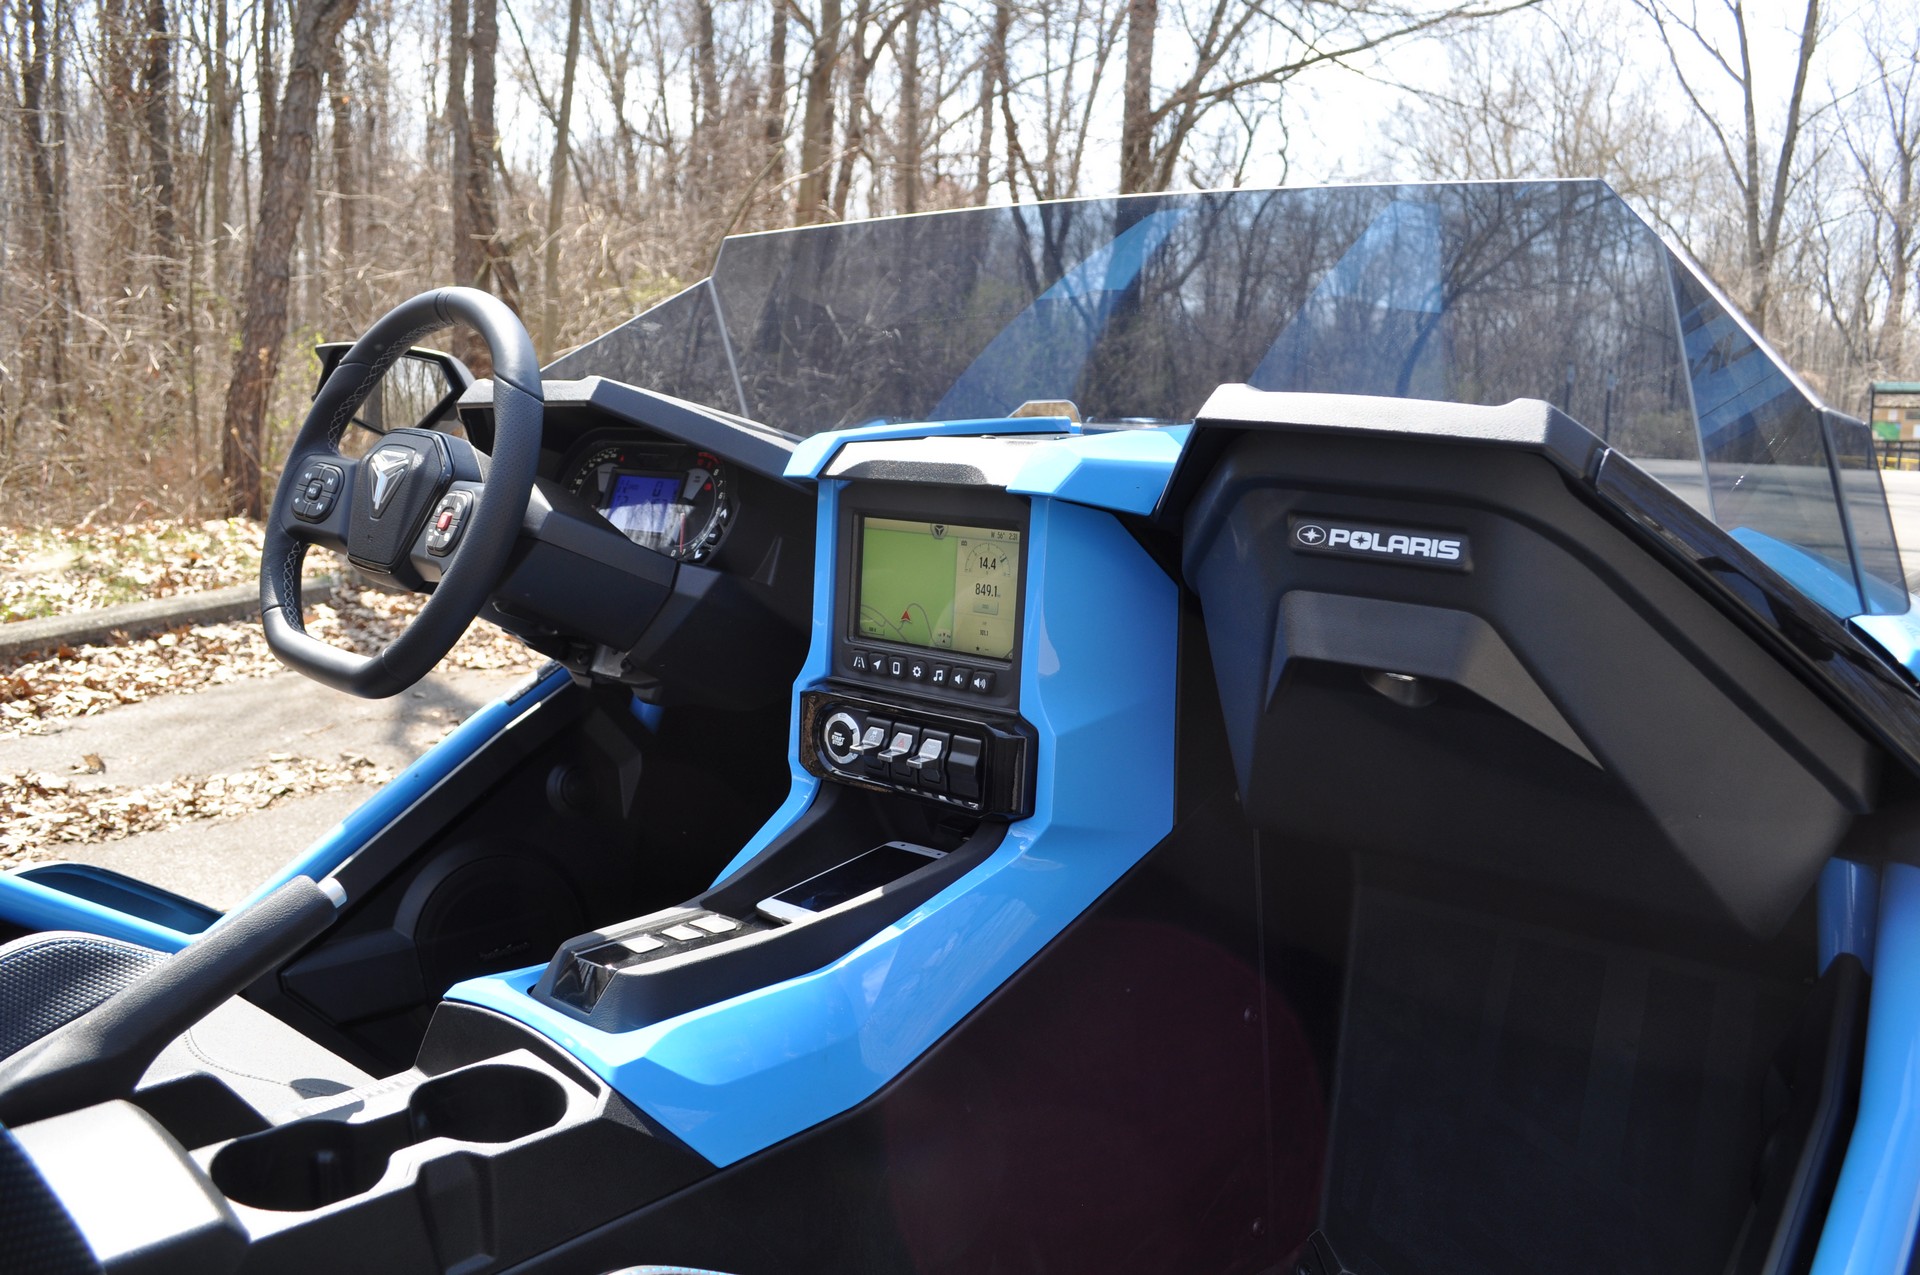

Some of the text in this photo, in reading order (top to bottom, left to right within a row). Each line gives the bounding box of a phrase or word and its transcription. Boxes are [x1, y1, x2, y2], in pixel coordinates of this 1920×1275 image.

[1328, 528, 1461, 560] POLARIS
[979, 556, 996, 570] 14.4
[975, 583, 998, 597] 849.1
